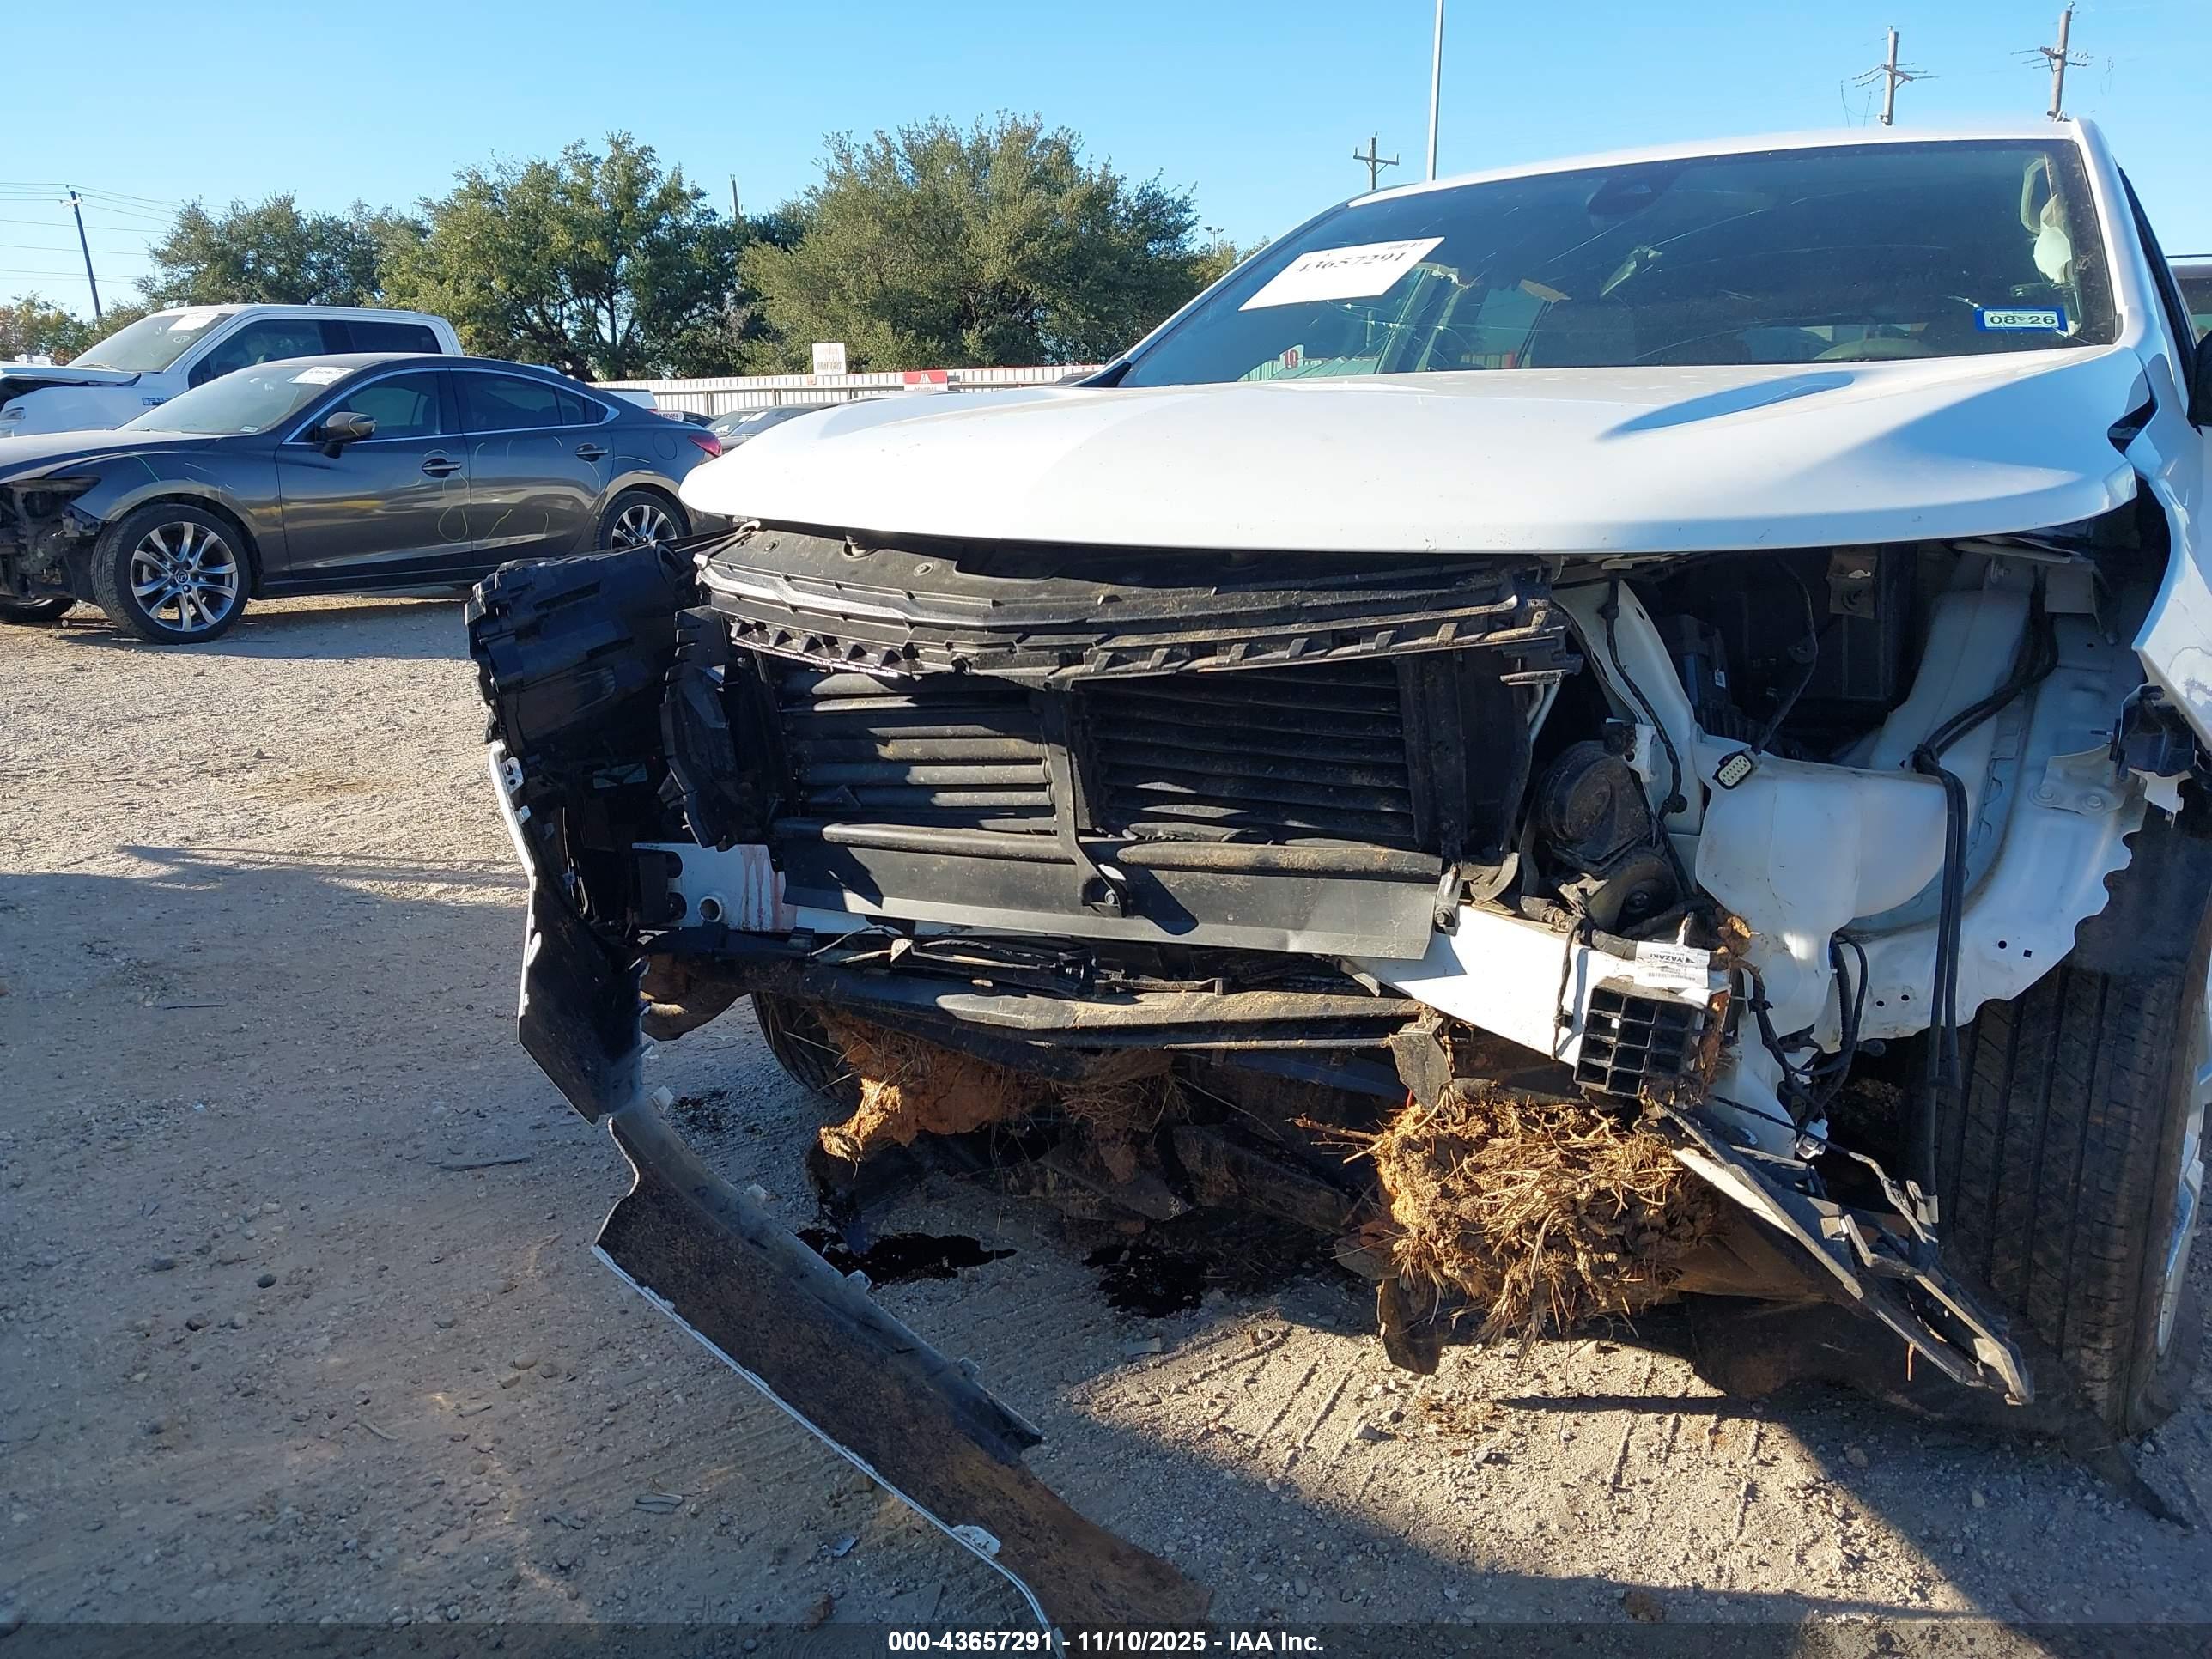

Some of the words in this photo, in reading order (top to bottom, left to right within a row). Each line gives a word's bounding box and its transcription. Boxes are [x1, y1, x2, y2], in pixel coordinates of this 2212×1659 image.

[1297, 252, 1407, 273] 43657291
[1990, 316, 2016, 325] 08
[2029, 316, 2056, 325] 26
